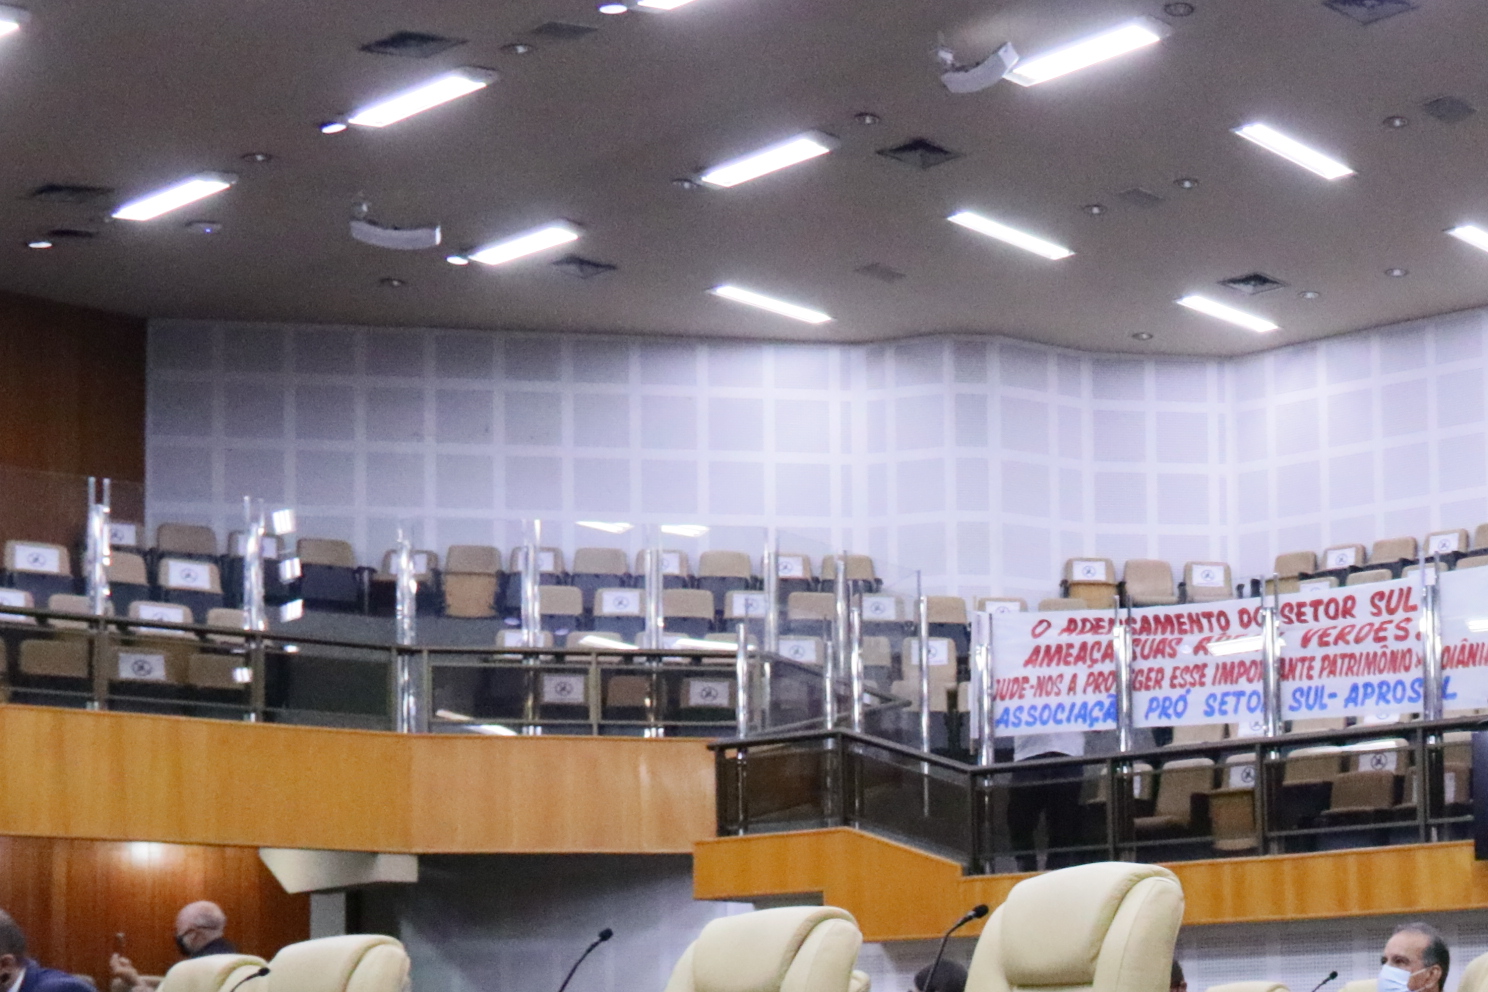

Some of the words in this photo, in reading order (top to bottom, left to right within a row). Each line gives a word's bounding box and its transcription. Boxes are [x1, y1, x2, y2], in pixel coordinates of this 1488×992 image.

[1031, 618, 1052, 640] O
[1237, 607, 1264, 630] DO
[1280, 594, 1357, 624] SETOR
[1370, 586, 1418, 618] SUL
[990, 673, 1064, 702] JUDE-NOS
[1066, 672, 1078, 696] A
[1082, 667, 1165, 696] PROGER
[1169, 662, 1208, 690] ESSE
[1318, 644, 1412, 680] PATRIMÔNIO
[1023, 639, 1116, 669] AMEAÇA
[995, 693, 1117, 729] ASSOCIAÇÃ
[1144, 688, 1192, 720] PRÓ
[1203, 689, 1264, 718] SETO
[1344, 676, 1457, 708] APROSL
